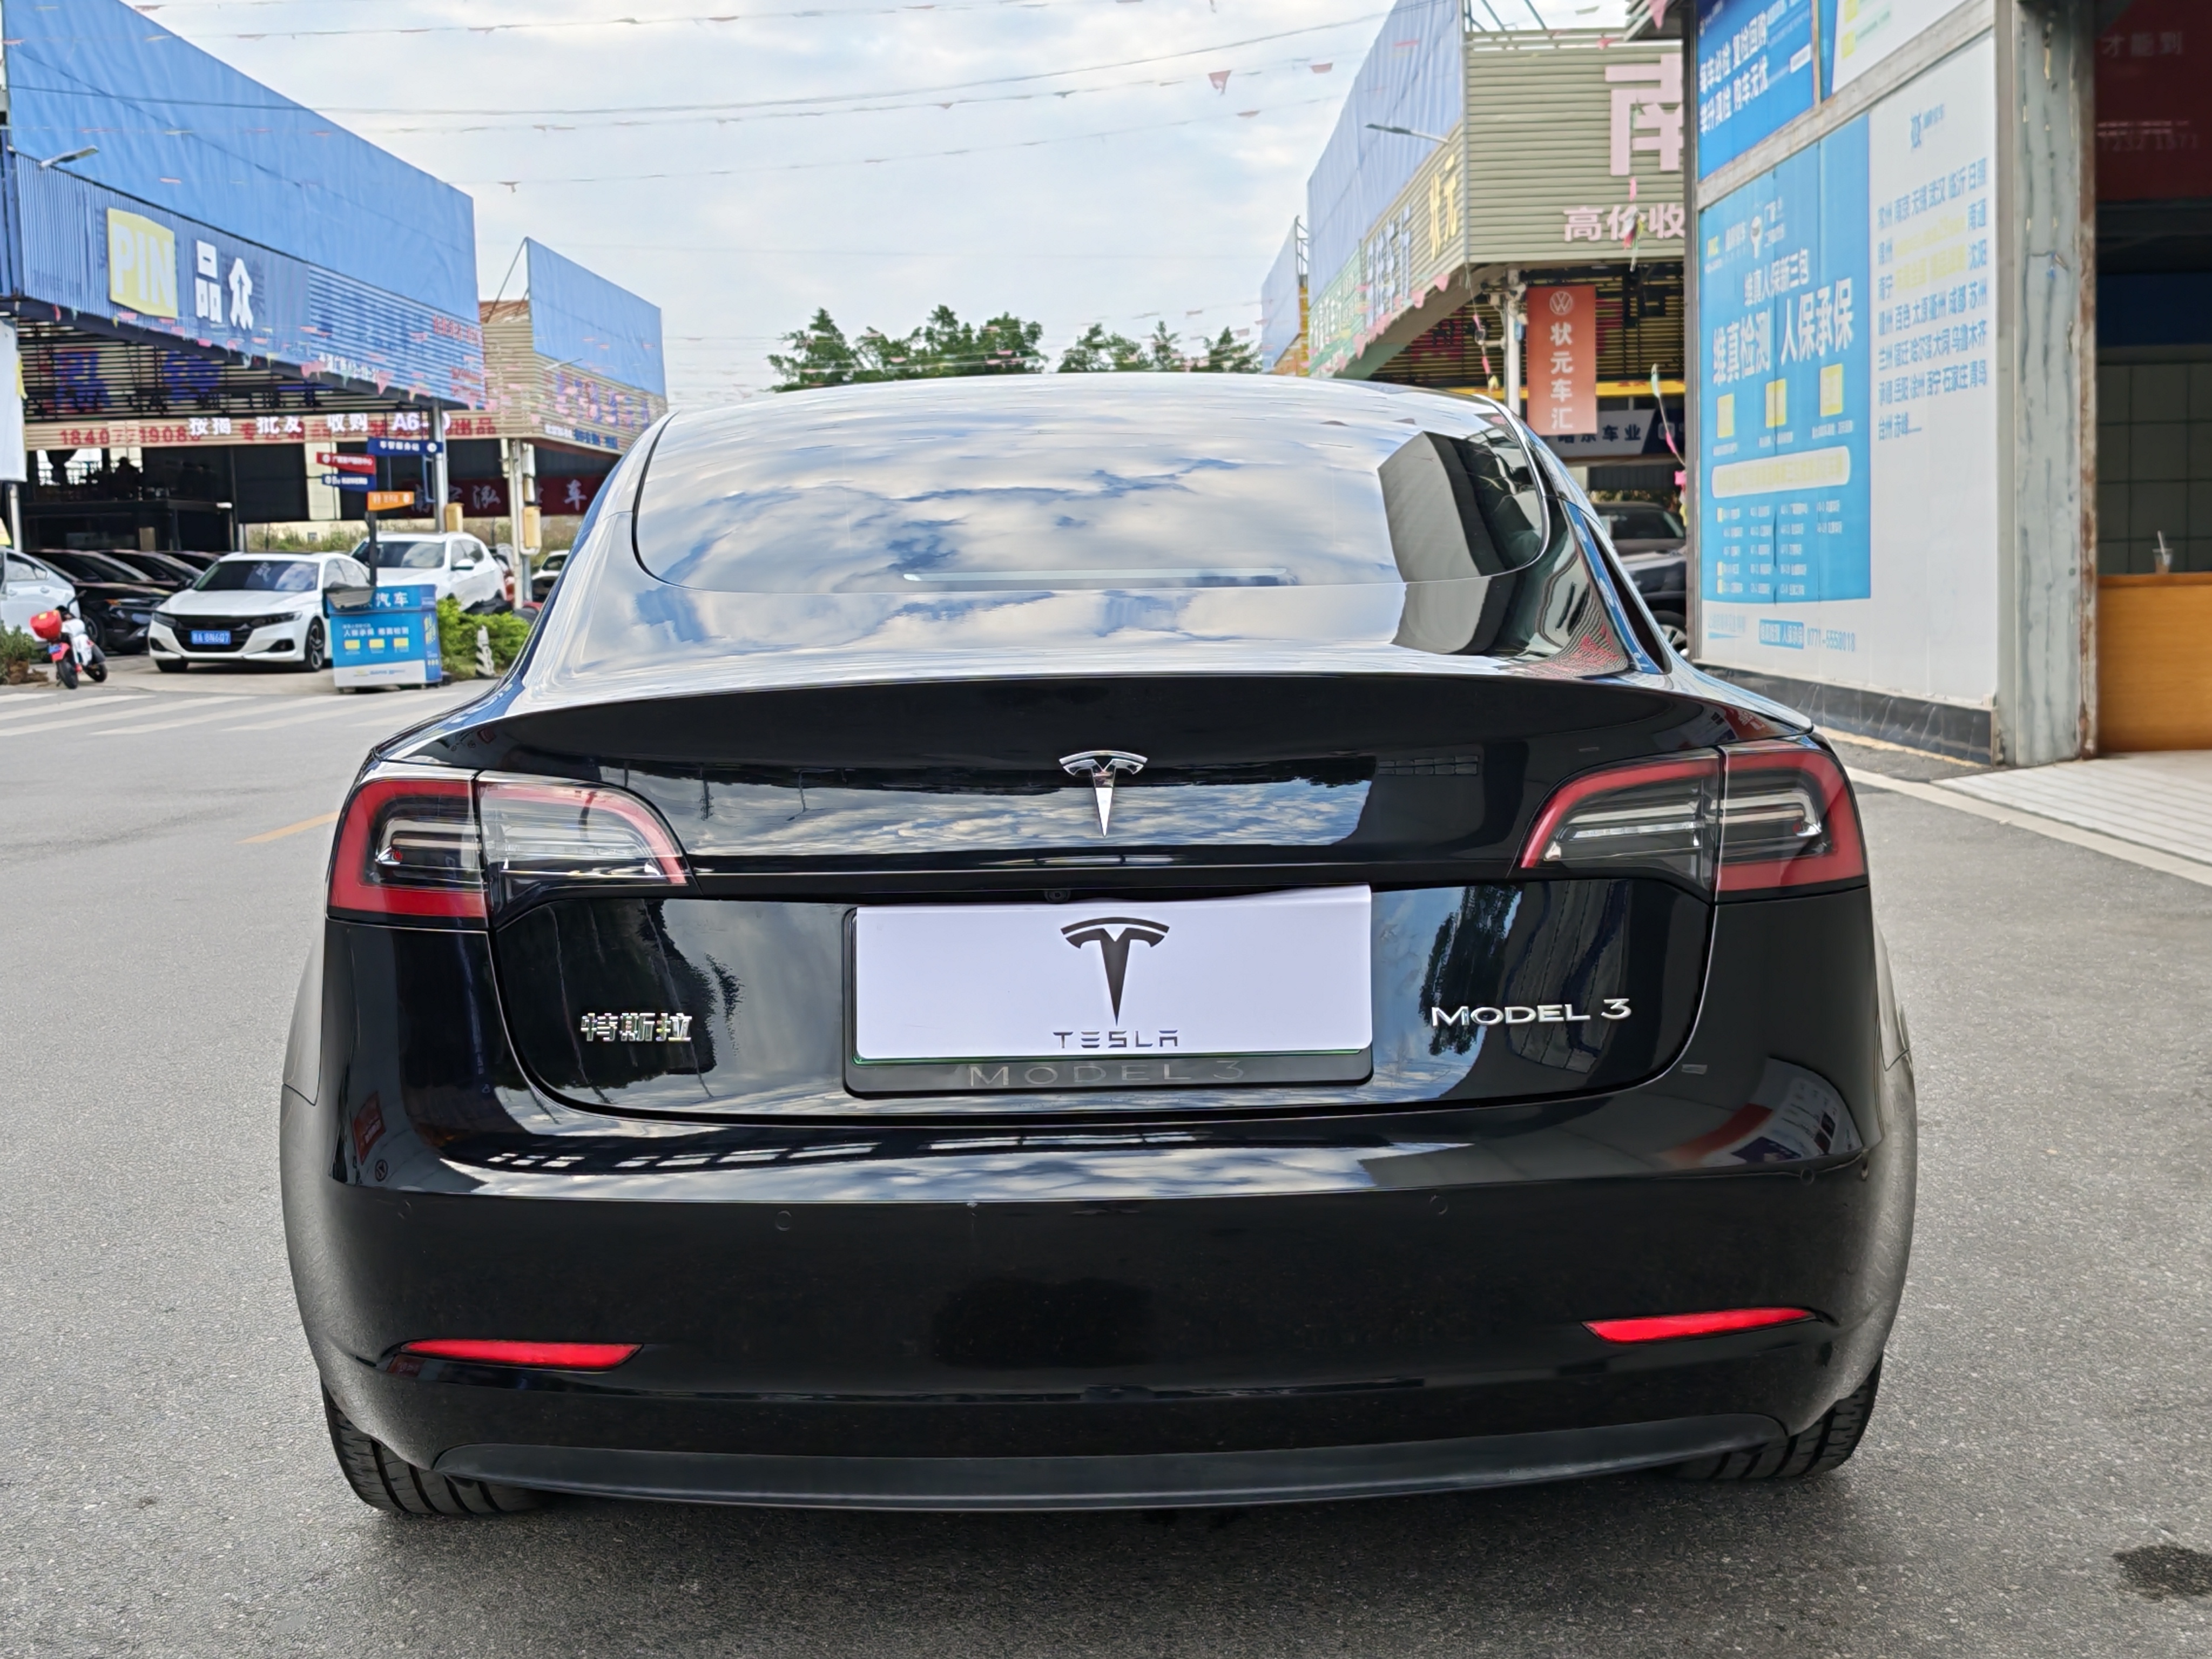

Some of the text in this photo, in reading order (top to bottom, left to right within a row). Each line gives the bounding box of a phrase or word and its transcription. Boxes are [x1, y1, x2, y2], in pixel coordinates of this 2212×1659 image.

[111, 222, 174, 309] PIN
[1781, 276, 1854, 366] 人保承保
[1550, 322, 1573, 430] 状元车汇
[1432, 998, 1631, 1026] MODEL 3
[581, 1013, 692, 1041] 特斯拉
[1053, 1030, 1178, 1048] TESLA
[970, 1060, 1244, 1087] MODEL 3
